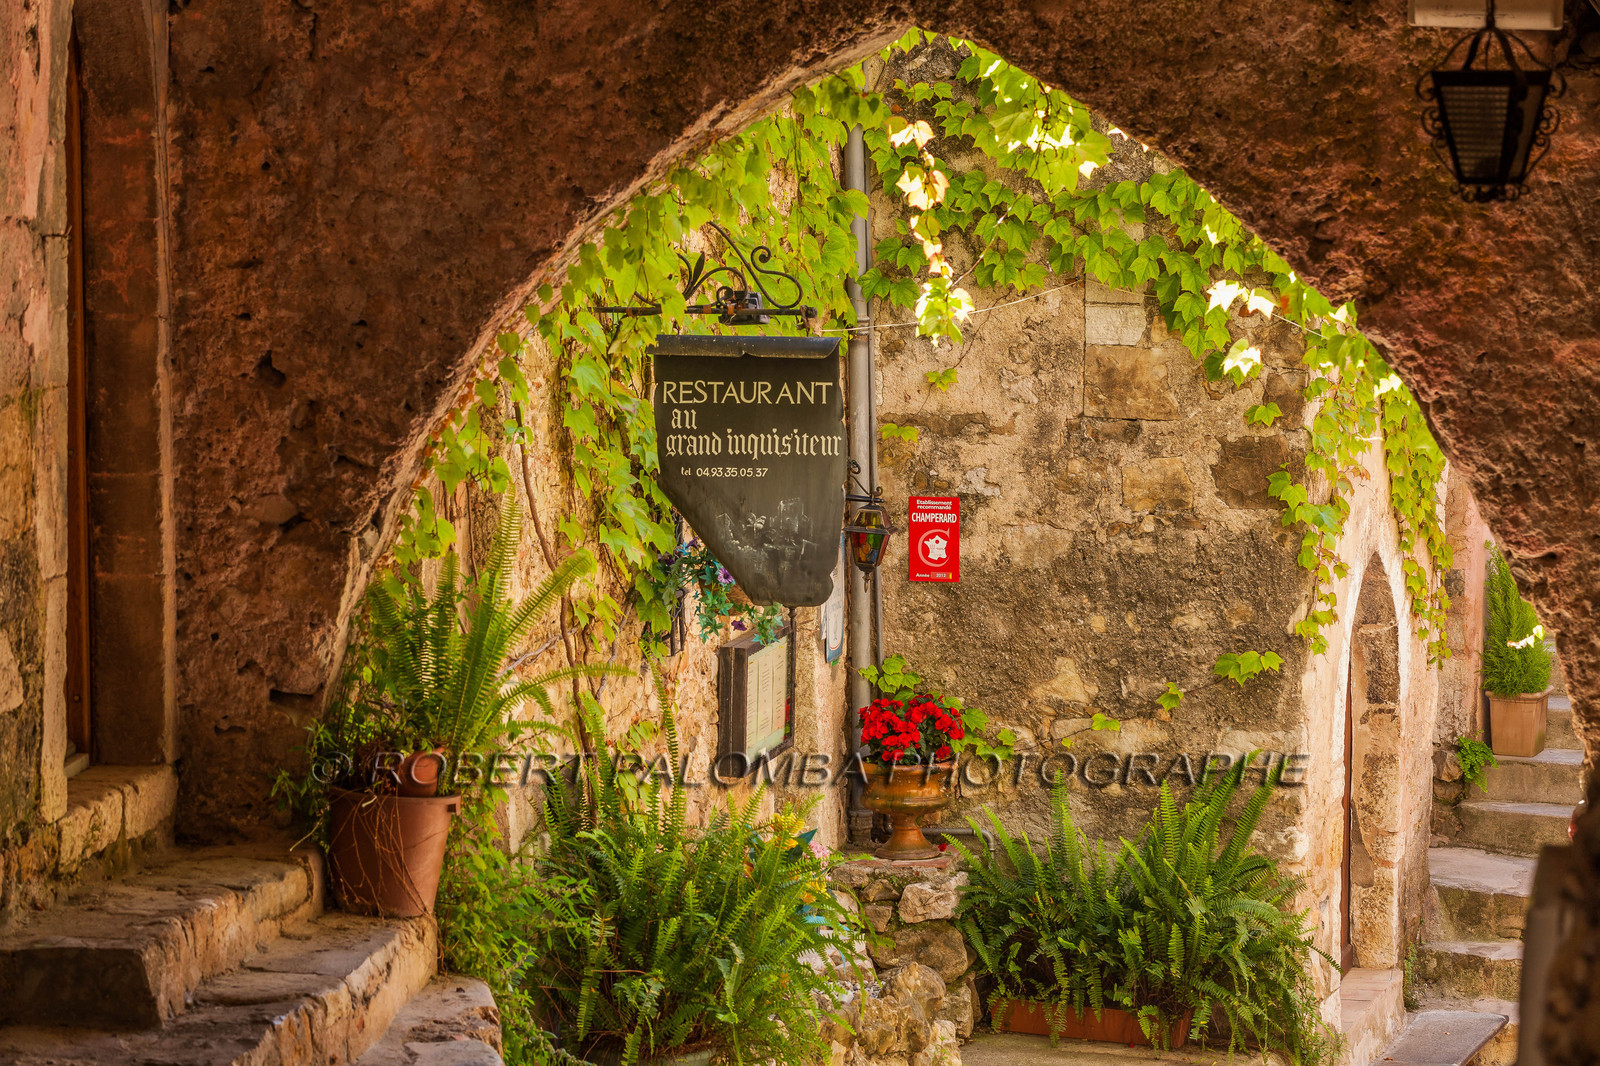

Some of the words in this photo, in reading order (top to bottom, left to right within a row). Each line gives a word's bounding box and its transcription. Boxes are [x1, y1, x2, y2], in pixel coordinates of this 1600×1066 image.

[662, 380, 833, 404] RESTAURANT
[671, 408, 698, 430] au
[665, 431, 722, 457] grand
[726, 428, 842, 461] inquisiteur
[681, 466, 692, 476] tel
[911, 512, 957, 523] CHAMPERARD
